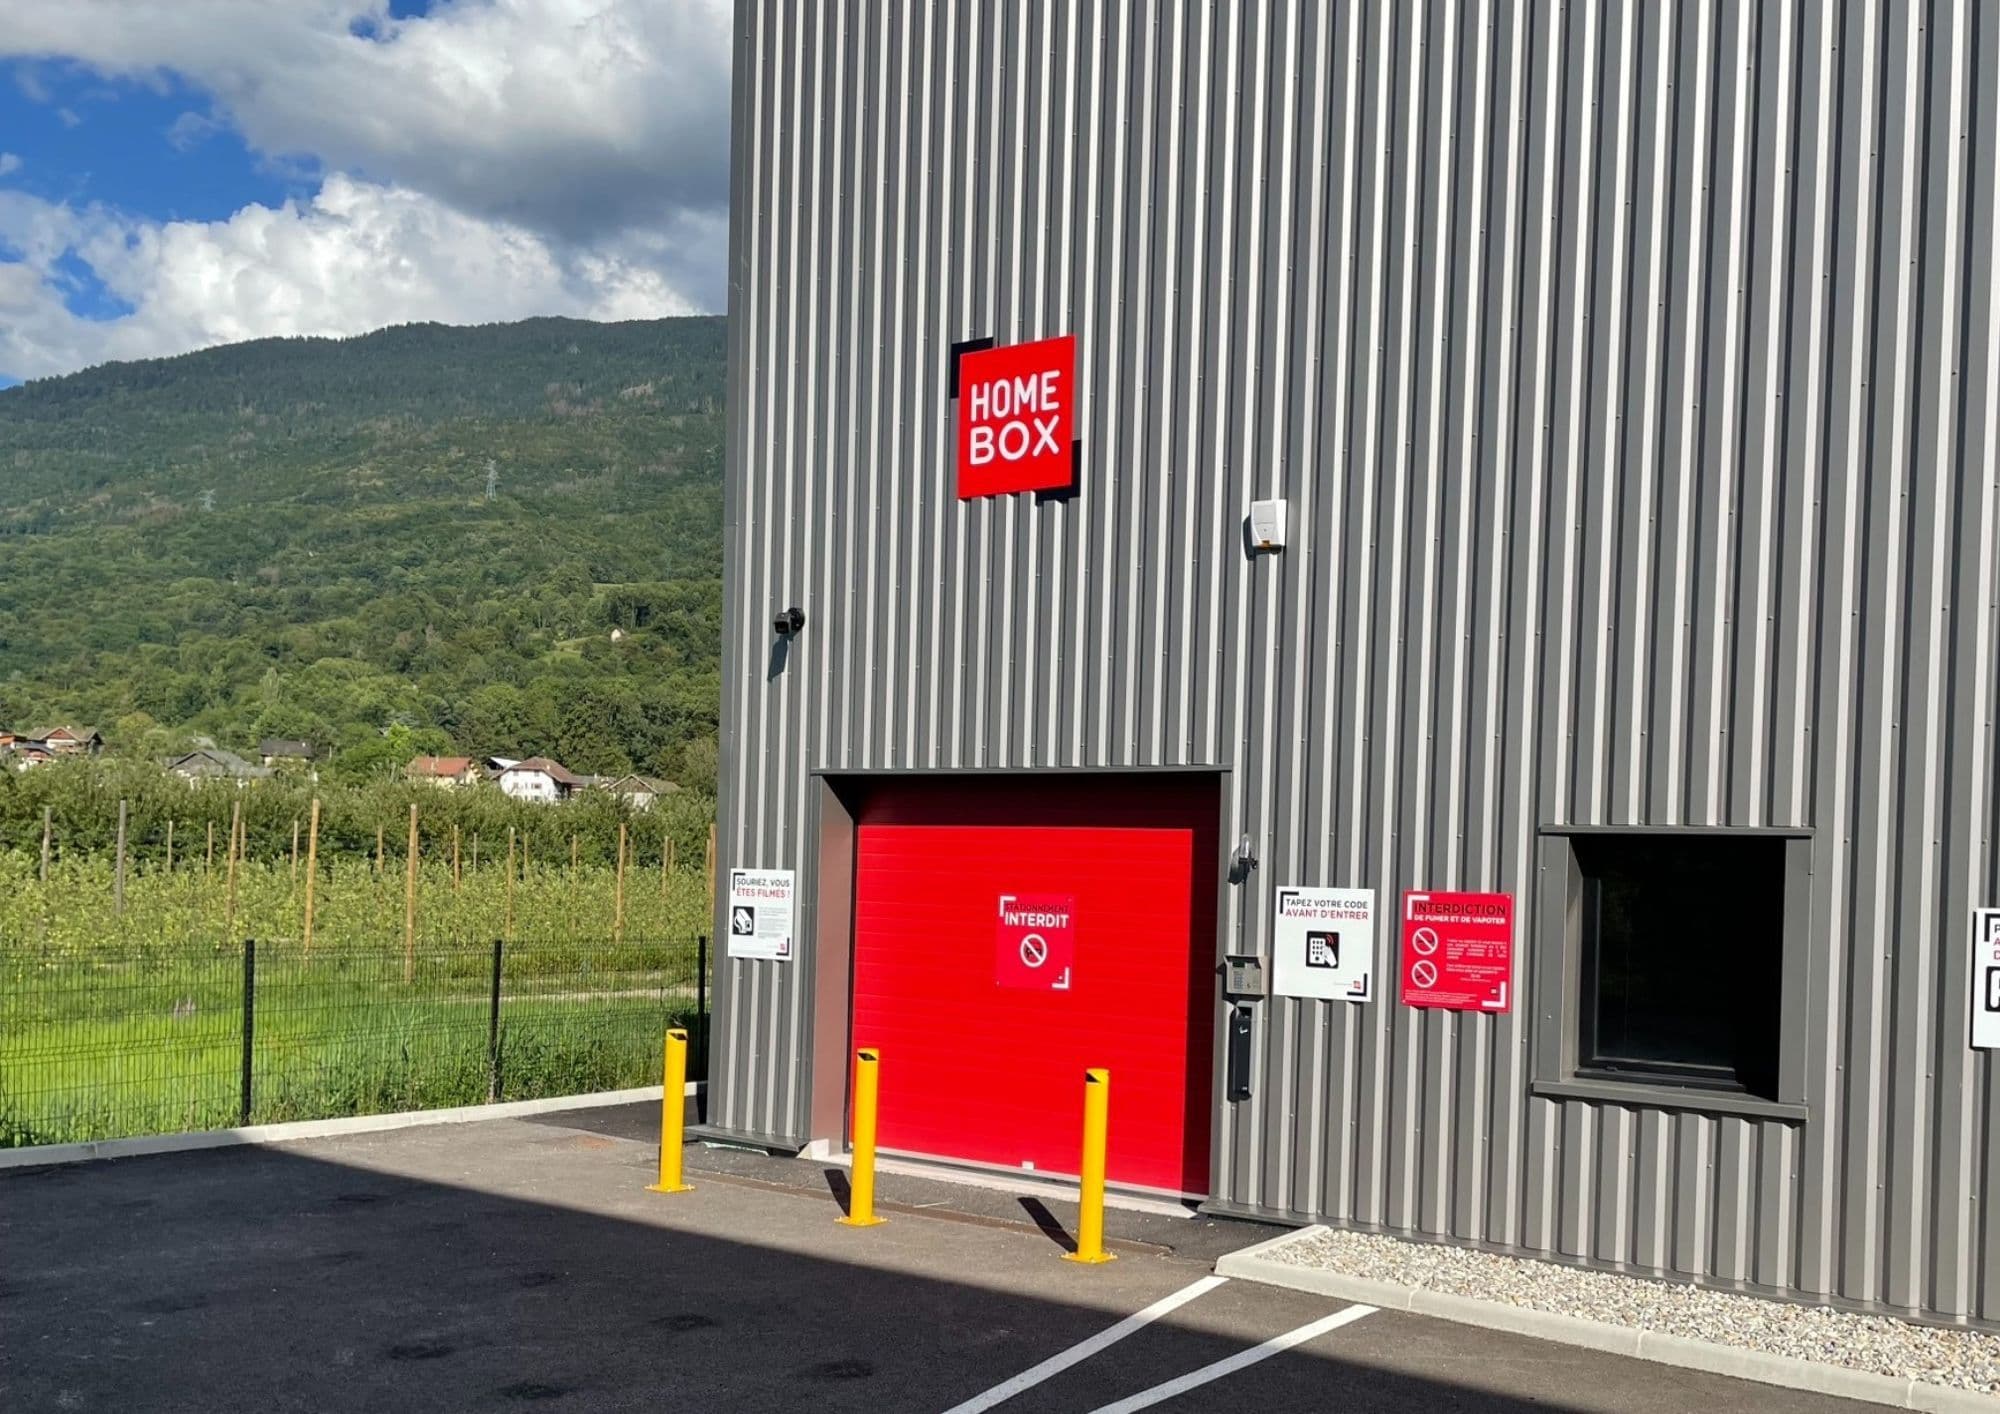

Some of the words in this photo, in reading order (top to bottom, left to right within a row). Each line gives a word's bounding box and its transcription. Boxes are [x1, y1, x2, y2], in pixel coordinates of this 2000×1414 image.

[970, 369, 1061, 423] HOME
[970, 414, 1060, 465] BOX
[770, 879, 790, 888] VOUS
[1286, 898, 1312, 907] TAPEZ
[1314, 899, 1342, 908] VOTRE
[1344, 900, 1368, 909] CODE
[1414, 902, 1506, 915] INTERDICTION
[1004, 912, 1069, 928] INTERDIT
[1285, 908, 1318, 918] AVANT
[1320, 909, 1369, 920] D'ENTRER
[1450, 915, 1460, 923] ET
[1472, 916, 1506, 925] VAPOTER
